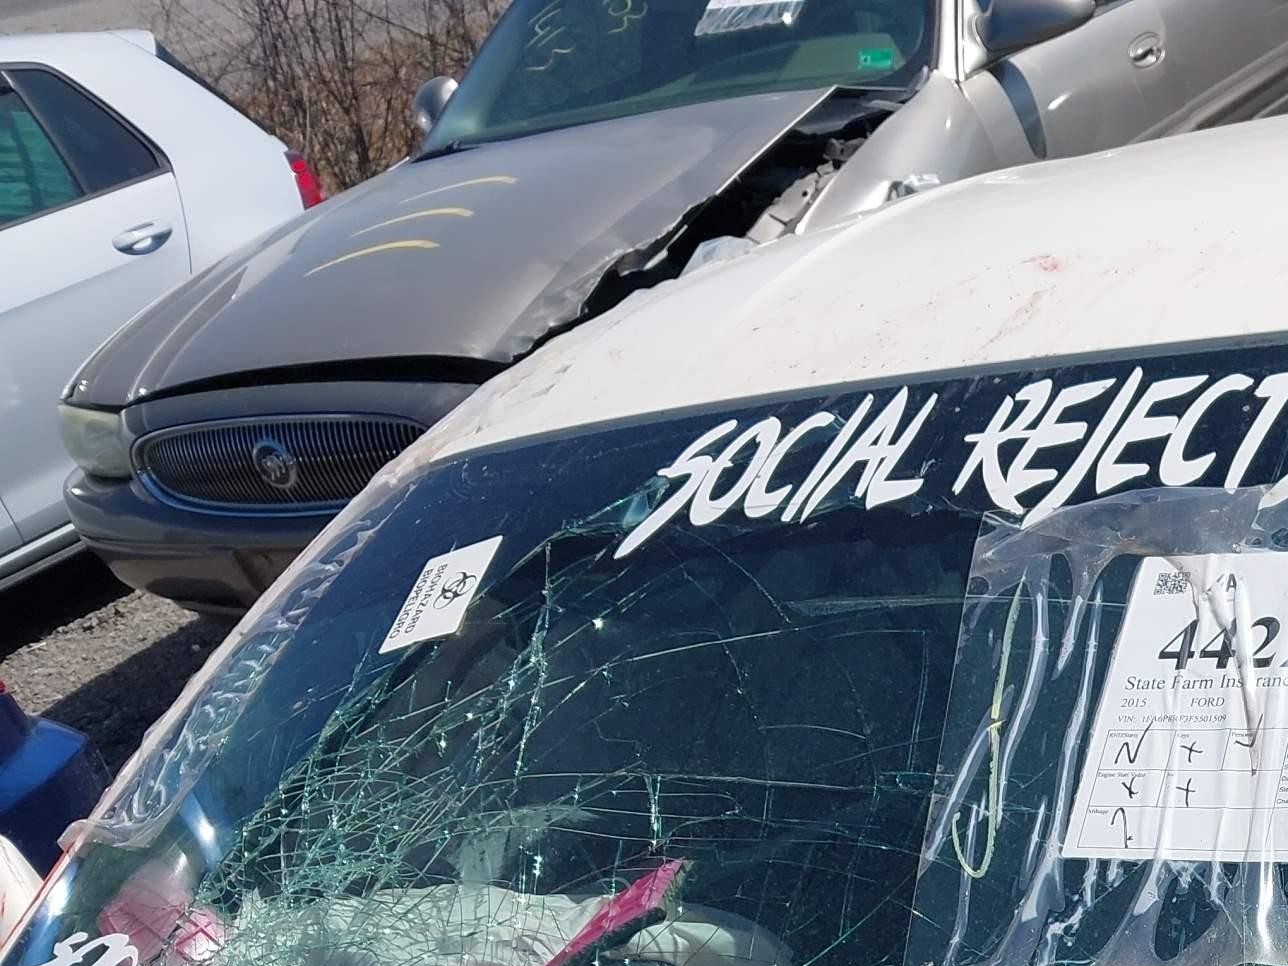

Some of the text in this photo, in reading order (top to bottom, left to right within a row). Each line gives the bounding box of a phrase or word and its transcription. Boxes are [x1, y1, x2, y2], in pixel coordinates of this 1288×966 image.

[614, 386, 936, 559] SOCIAL
[388, 569, 434, 639] BIOPELIGRO
[404, 563, 448, 634] BIOHAZARD
[1120, 697, 1148, 708] 2015
[1190, 697, 1225, 708] FORD
[1125, 675, 1166, 690] State
[1170, 674, 1214, 690] Farm
[1118, 714, 1136, 723] VIN:
